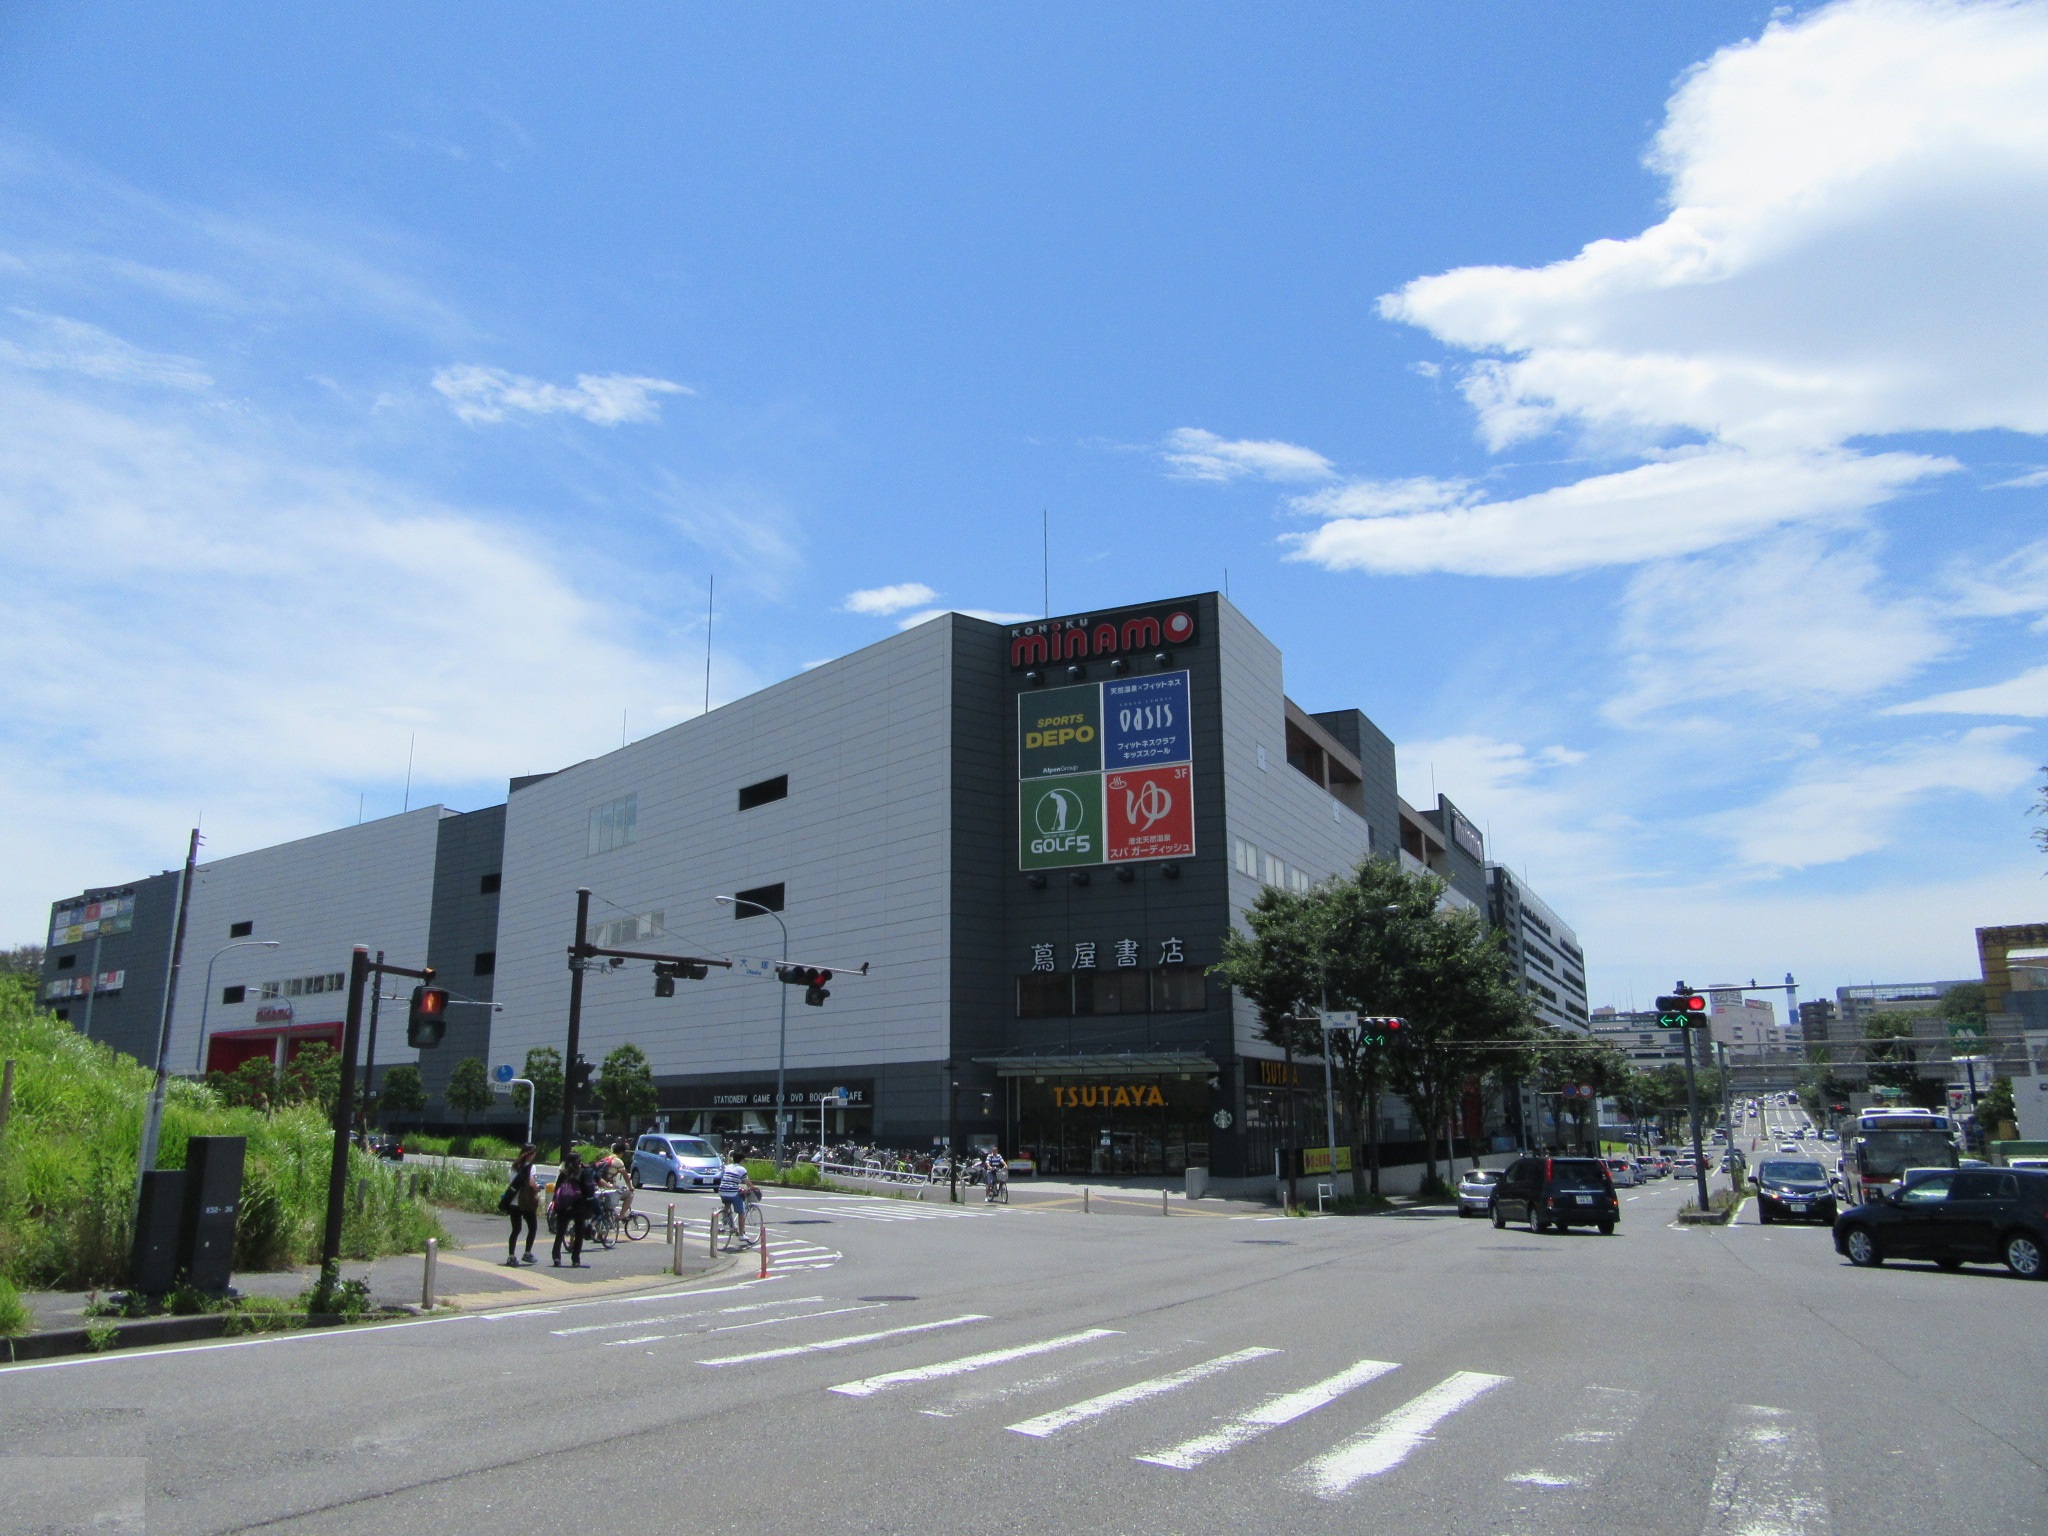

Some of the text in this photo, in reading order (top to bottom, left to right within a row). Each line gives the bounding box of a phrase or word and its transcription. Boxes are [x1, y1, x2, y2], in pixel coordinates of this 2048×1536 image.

[1037, 714, 1084, 728] SPORTS
[1026, 725, 1095, 749] DEPO
[1123, 747, 1171, 759] キッズスクール
[1174, 768, 1188, 778] 3F
[1126, 780, 1172, 832] ゆ
[1110, 843, 1191, 858] スパ ガーディッシュ
[1030, 936, 1184, 972] 蔦屋書店
[1261, 1061, 1299, 1087] TSUTAA
[713, 1094, 748, 1104] STATIONERY
[752, 1094, 771, 1103] GAME
[790, 1092, 804, 1102] DVD
[1053, 1085, 1165, 1108] TSUTAYA
